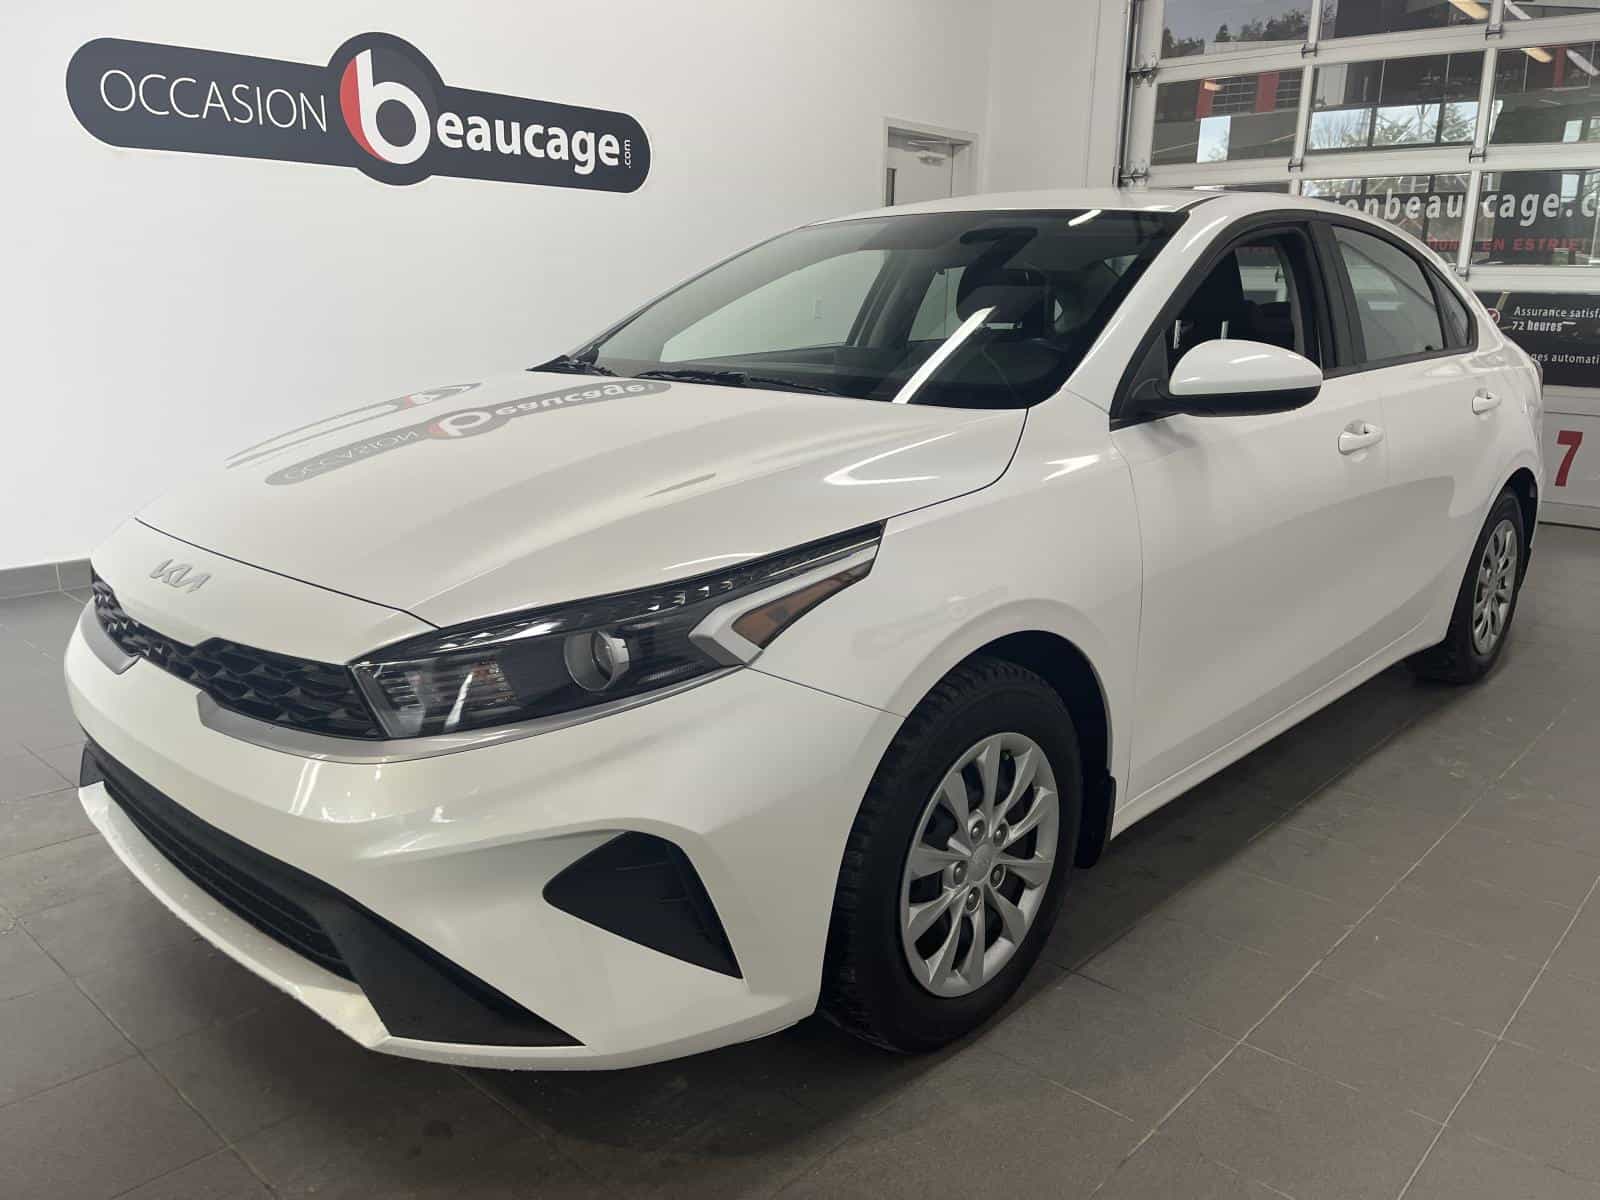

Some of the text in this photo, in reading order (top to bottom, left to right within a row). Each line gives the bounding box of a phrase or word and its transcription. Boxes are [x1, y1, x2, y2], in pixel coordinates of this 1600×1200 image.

[99, 69, 328, 133] OCCASION
[1511, 320, 1562, 332] 72 heures
[1513, 306, 1567, 318] Assurance
[1554, 429, 1584, 488] 7
